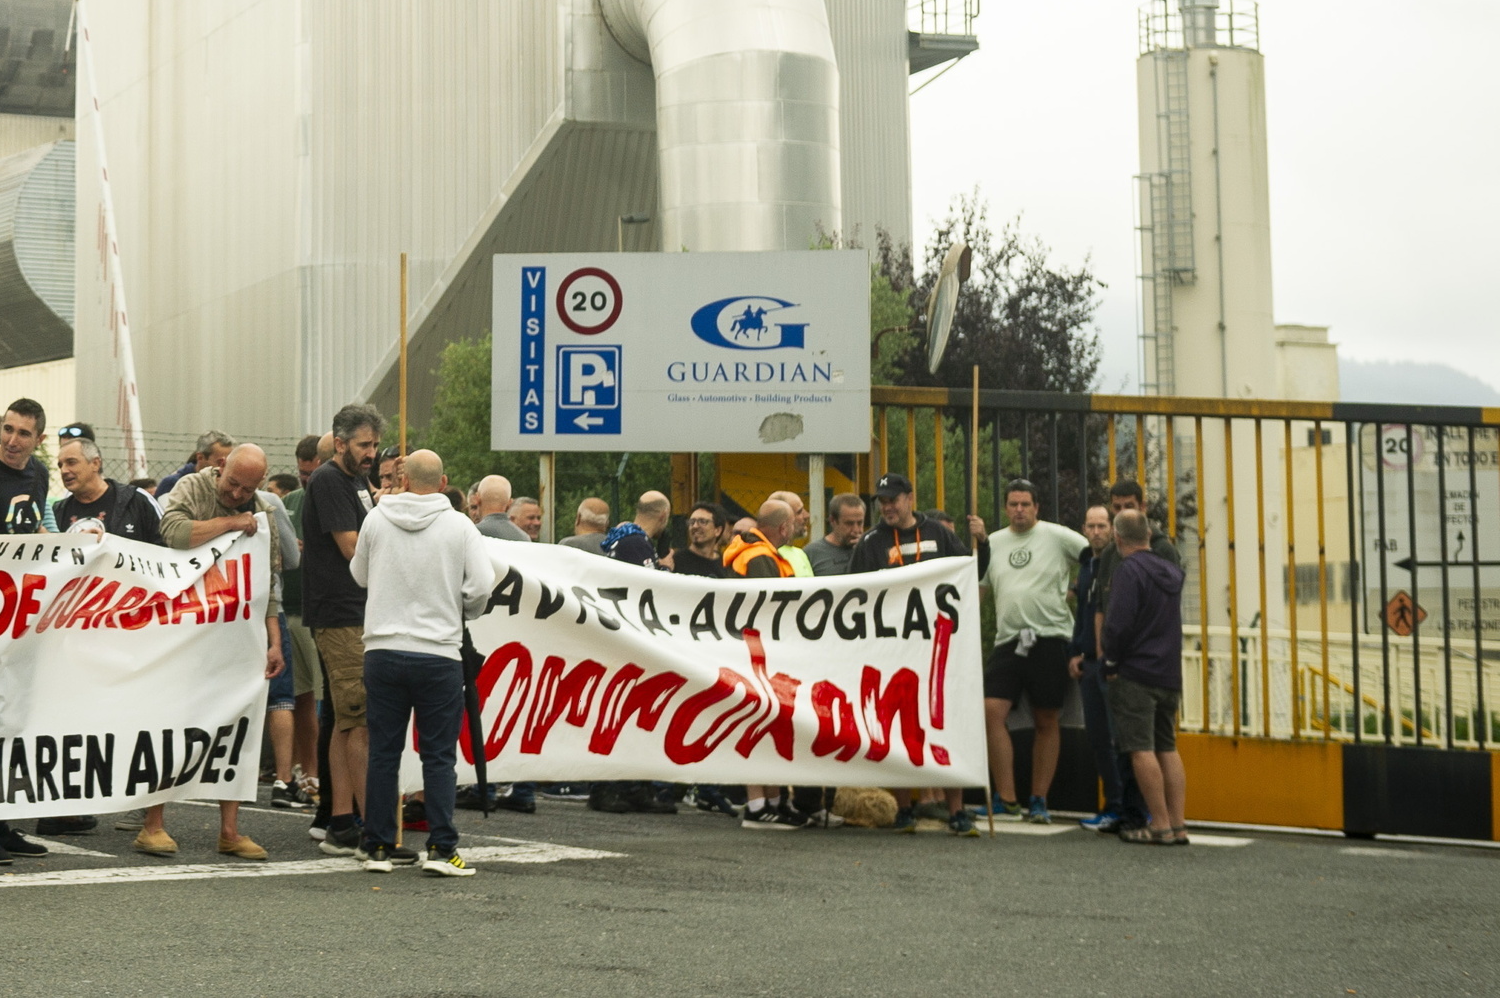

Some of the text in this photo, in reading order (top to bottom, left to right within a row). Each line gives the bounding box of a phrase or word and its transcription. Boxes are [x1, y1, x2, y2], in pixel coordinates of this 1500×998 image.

[572, 291, 608, 312] 20
[524, 271, 541, 430] VISITAS
[570, 353, 609, 403] P
[667, 362, 832, 383] GUARDIAN
[667, 393, 832, 404] Glass Automotive Building Products
[125, 716, 250, 796] ALDE!
